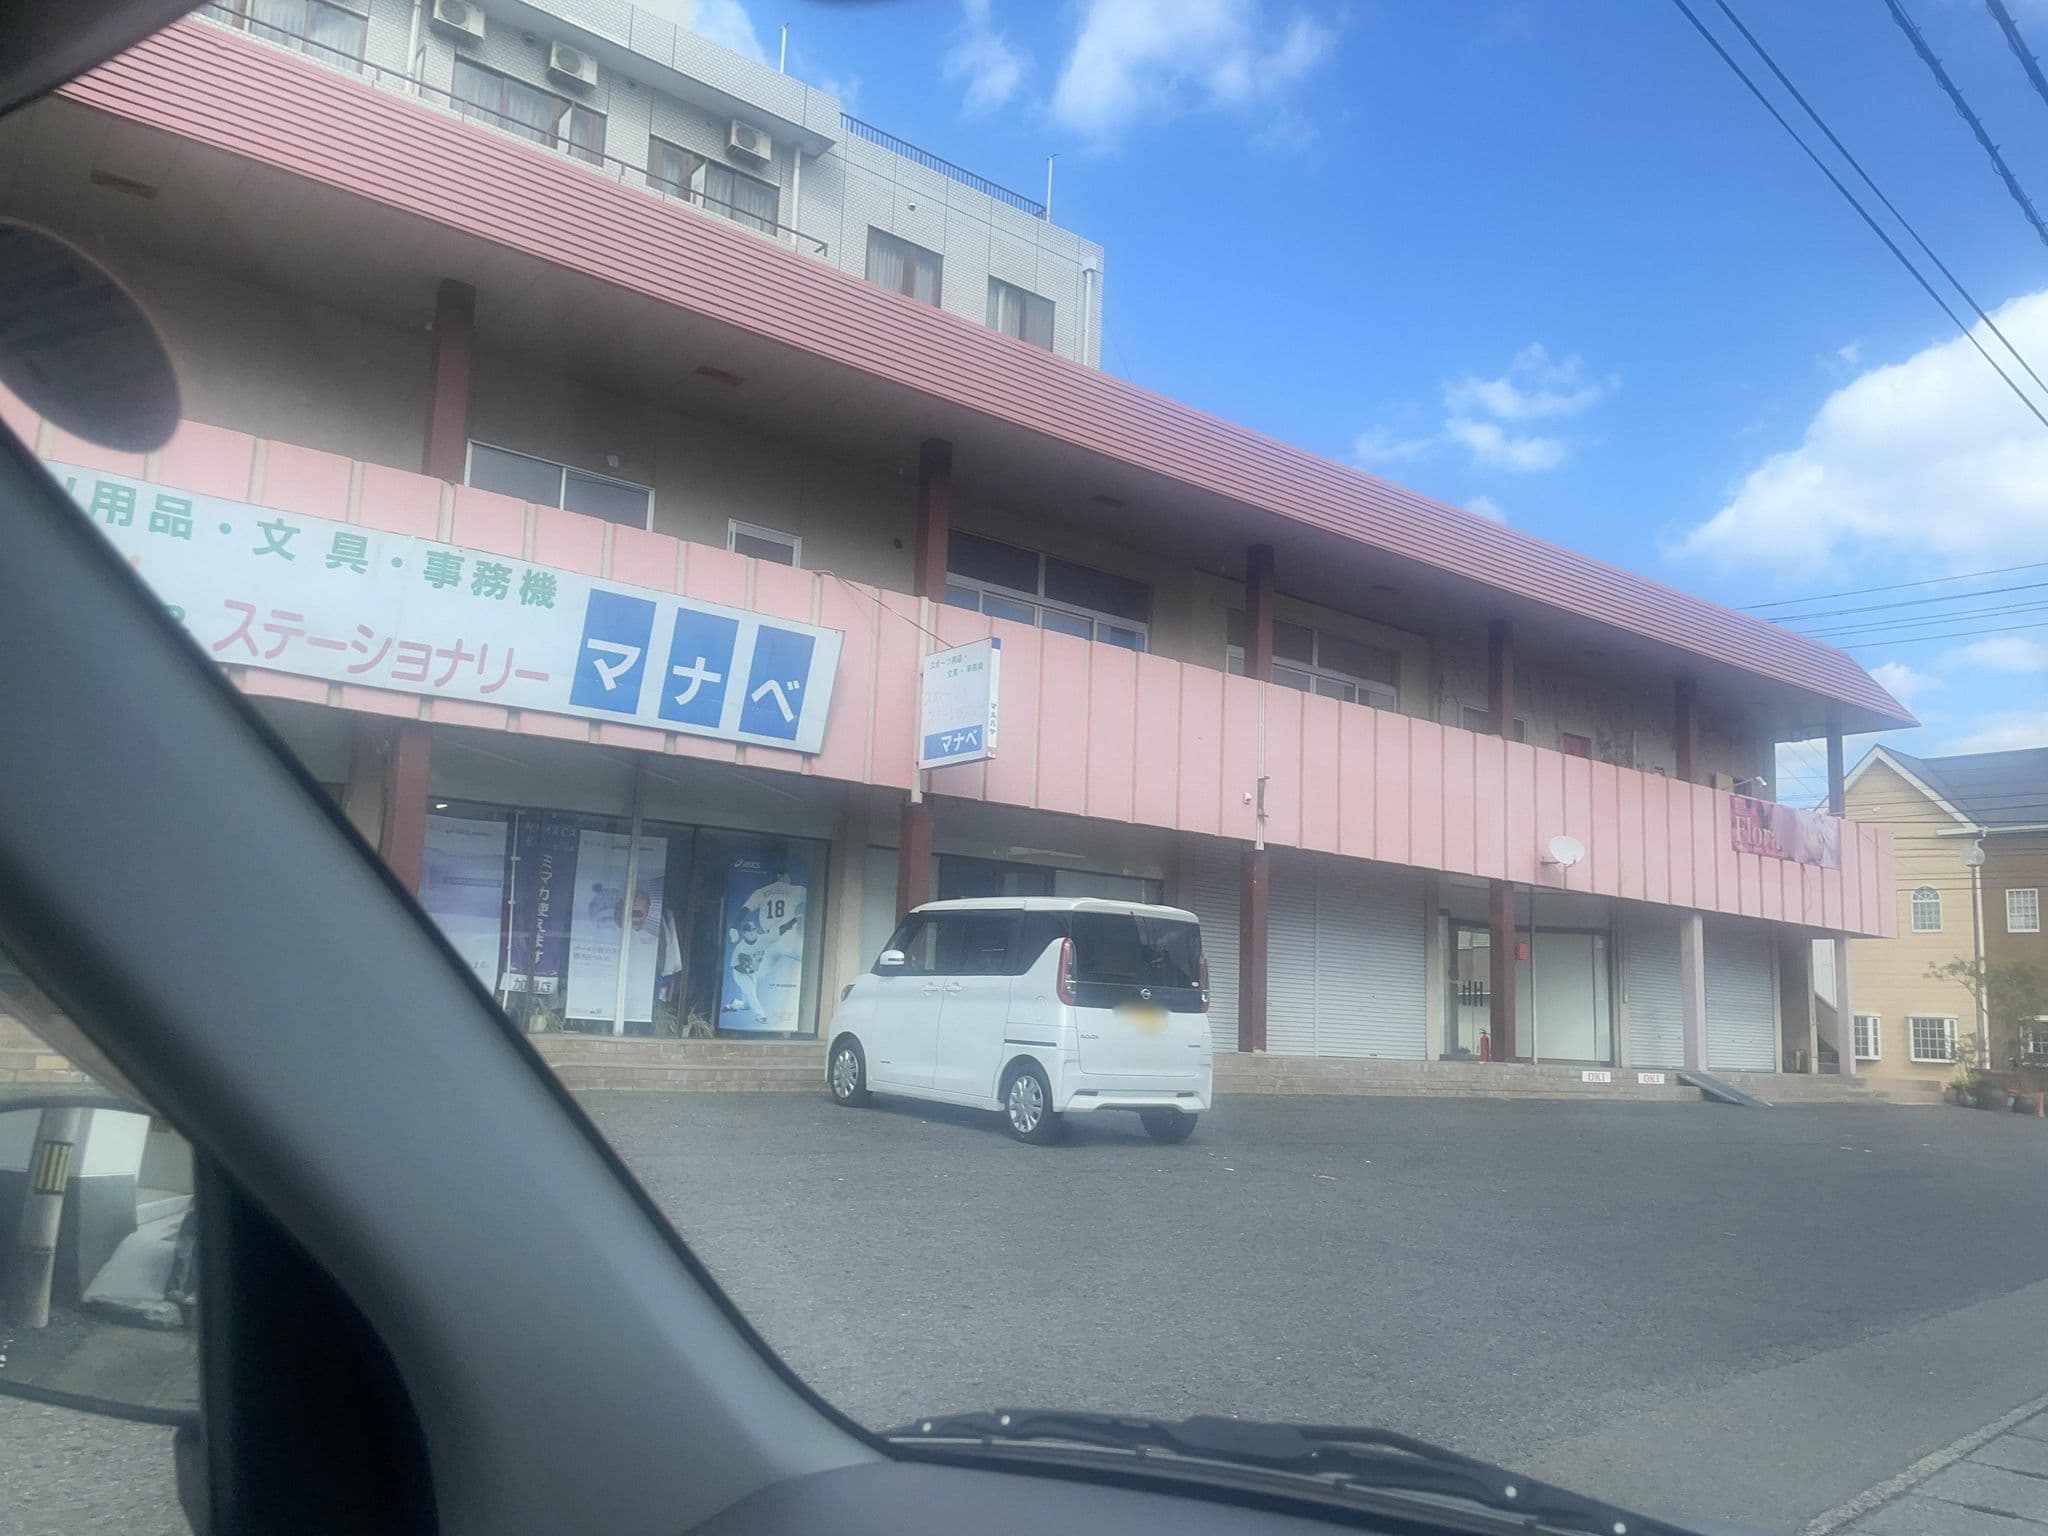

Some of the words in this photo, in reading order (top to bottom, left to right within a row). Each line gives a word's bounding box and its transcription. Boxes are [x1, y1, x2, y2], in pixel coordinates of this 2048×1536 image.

[212, 599, 549, 694] ステーショナリー
[587, 638, 800, 723] マナベ
[941, 729, 978, 752] マナベ
[766, 899, 785, 919] 18
[1588, 1072, 1605, 1082] OKI
[1643, 1074, 1660, 1083] OKI
